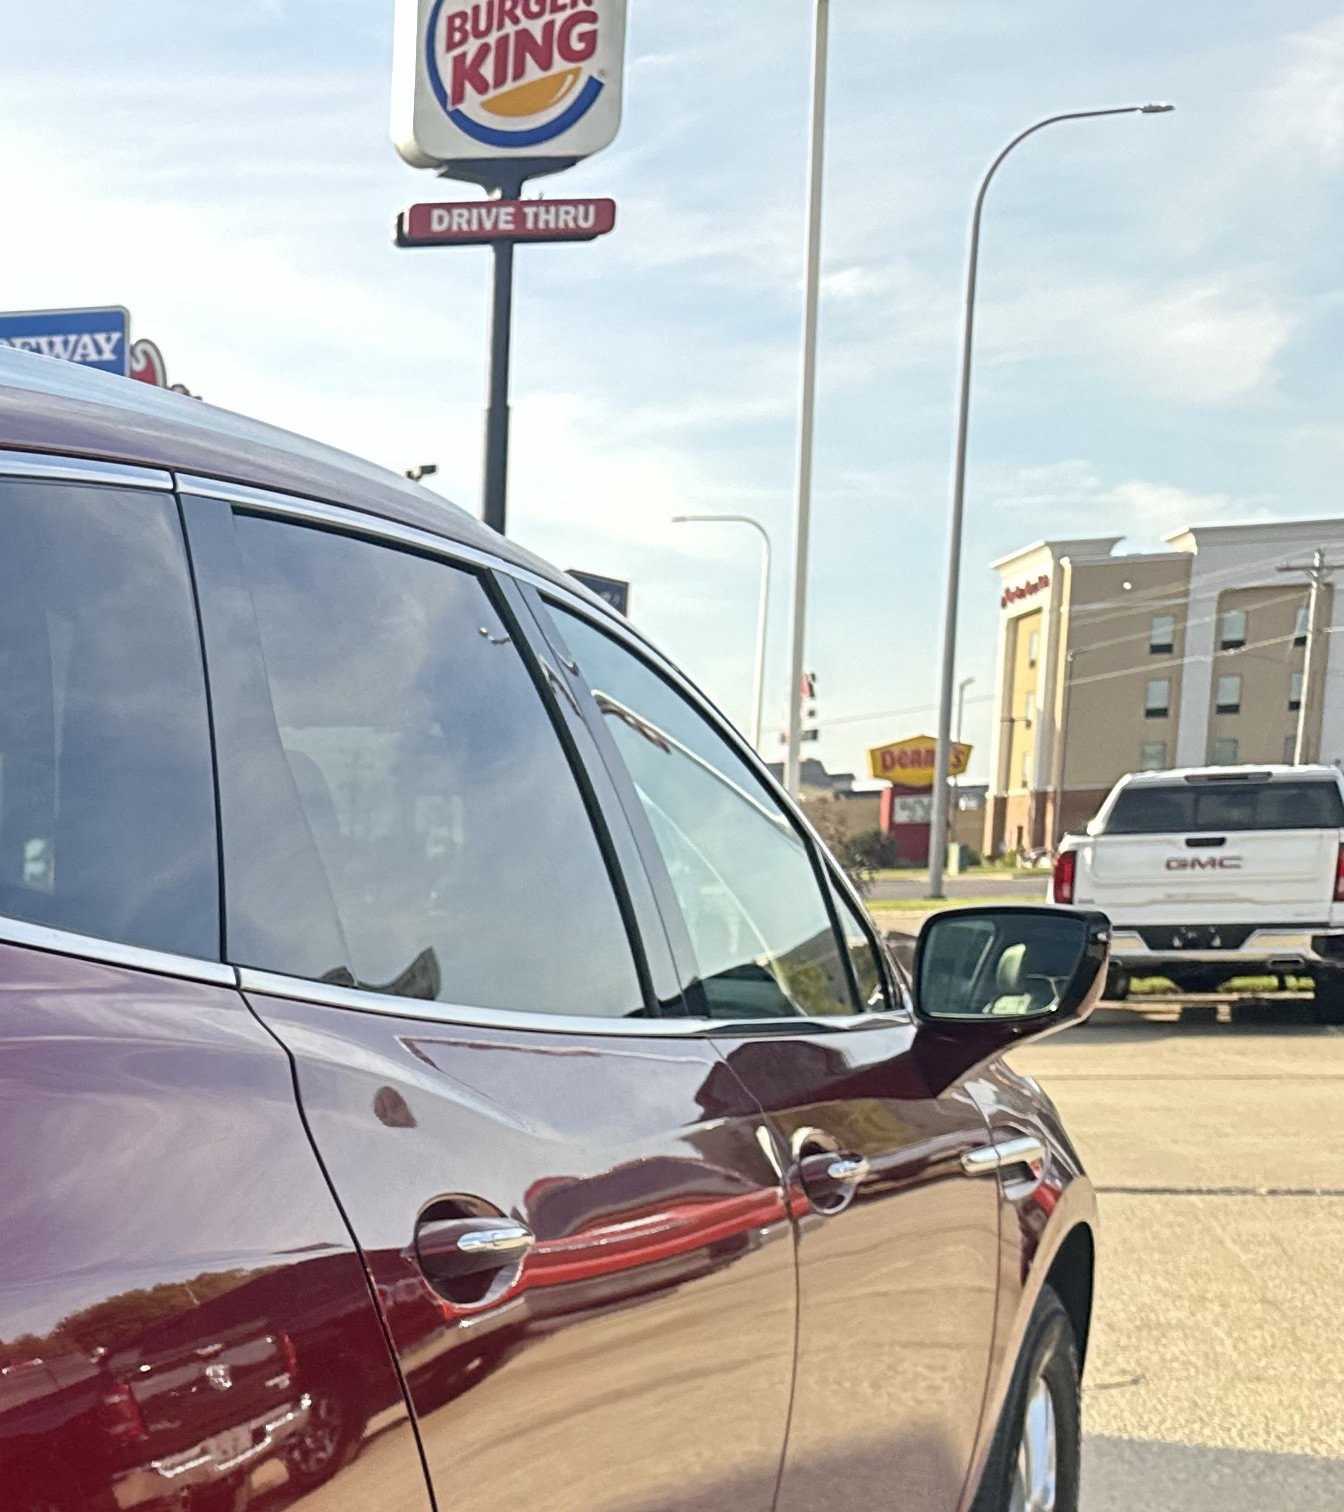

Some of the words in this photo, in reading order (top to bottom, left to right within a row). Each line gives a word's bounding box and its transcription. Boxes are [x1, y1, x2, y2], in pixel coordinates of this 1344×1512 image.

[445, 0, 593, 53] BURG
[448, 10, 598, 108] KING
[430, 208, 515, 232] DRIVE
[524, 204, 596, 229] THRU
[1165, 856, 1243, 871] GMC
